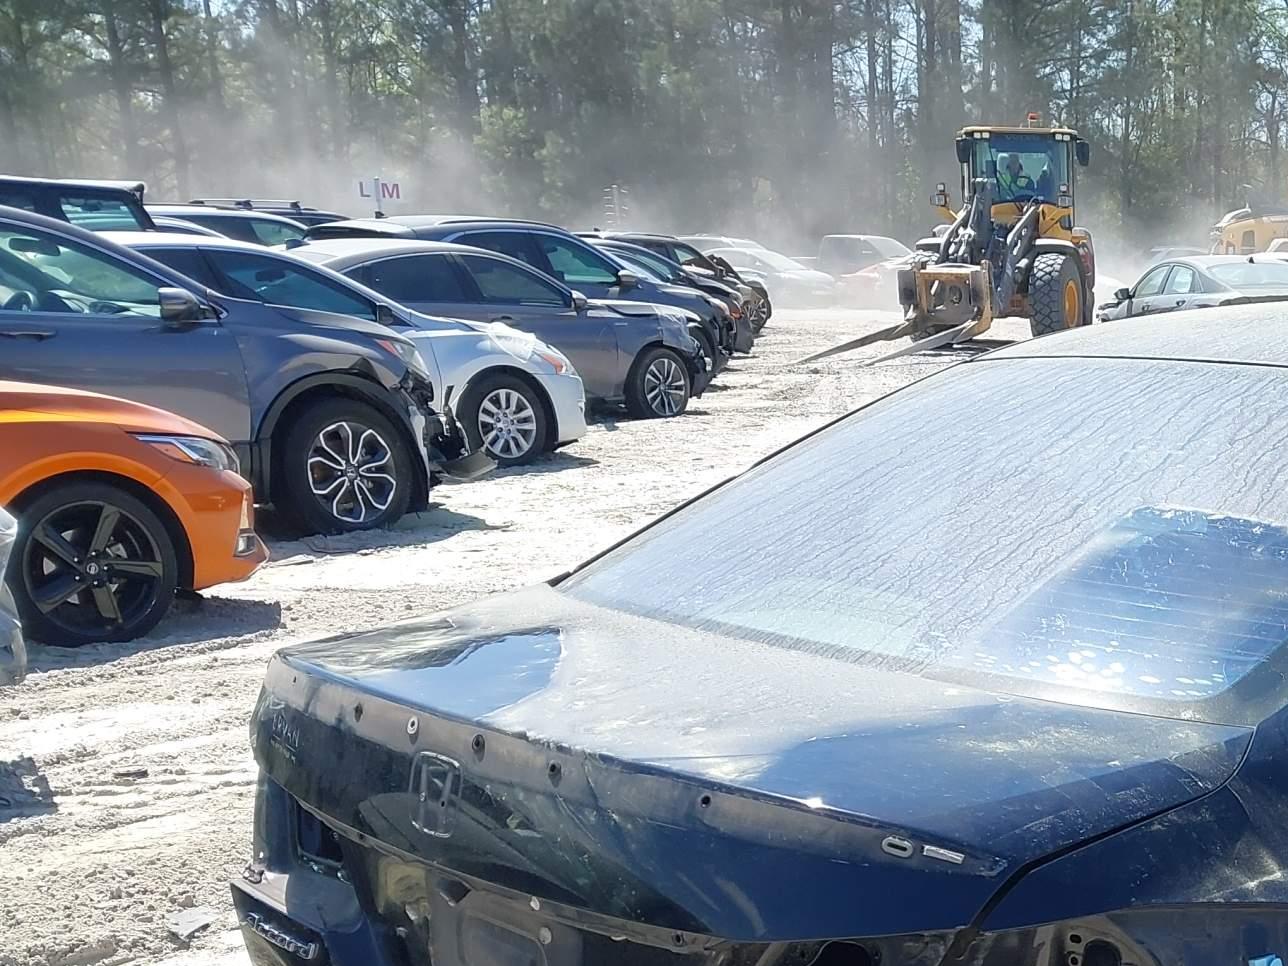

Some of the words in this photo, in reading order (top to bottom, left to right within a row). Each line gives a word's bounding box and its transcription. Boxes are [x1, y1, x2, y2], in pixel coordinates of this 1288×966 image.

[359, 181, 371, 198] L
[381, 182, 401, 200] M
[246, 911, 319, 960] Accord
